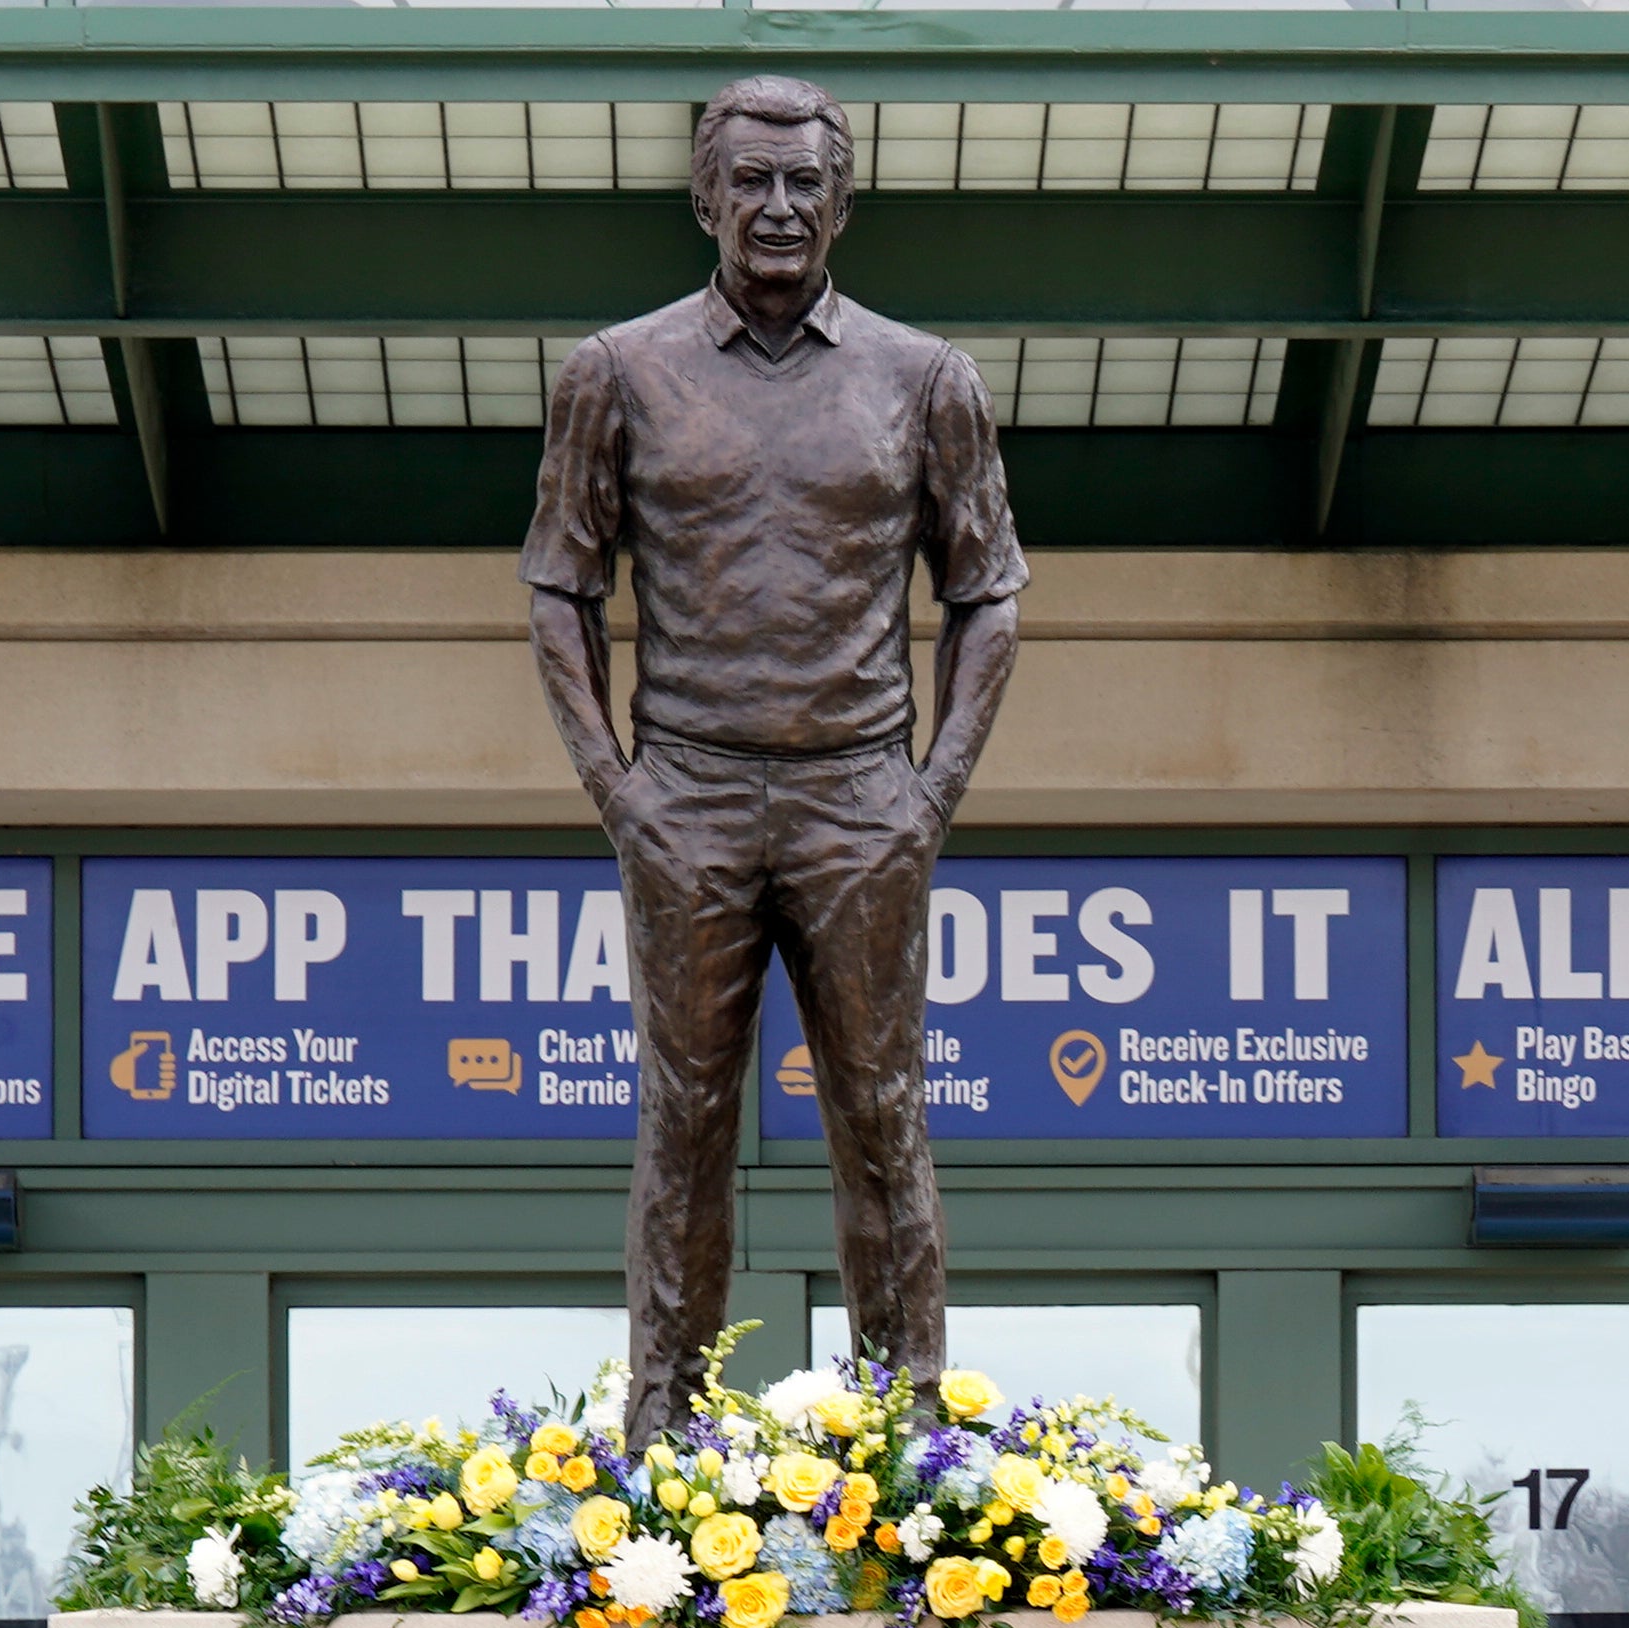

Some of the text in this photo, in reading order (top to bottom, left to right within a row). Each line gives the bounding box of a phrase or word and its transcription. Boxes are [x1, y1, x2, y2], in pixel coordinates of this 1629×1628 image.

[112, 888, 348, 1001] APP
[401, 888, 632, 1001] THA
[924, 887, 1155, 1005] OES
[1228, 888, 1350, 1001] IT
[187, 1028, 359, 1063] Access Your
[538, 1028, 606, 1064] Chat
[1119, 1027, 1368, 1062] Receive Exclusive
[1516, 1027, 1577, 1067] Play
[187, 1070, 390, 1113] Digital Tickets
[538, 1071, 632, 1106] Bernie
[1119, 1070, 1343, 1105] Check-In Offers
[1516, 1068, 1596, 1110] Bingo
[1512, 1468, 1591, 1531] 17
